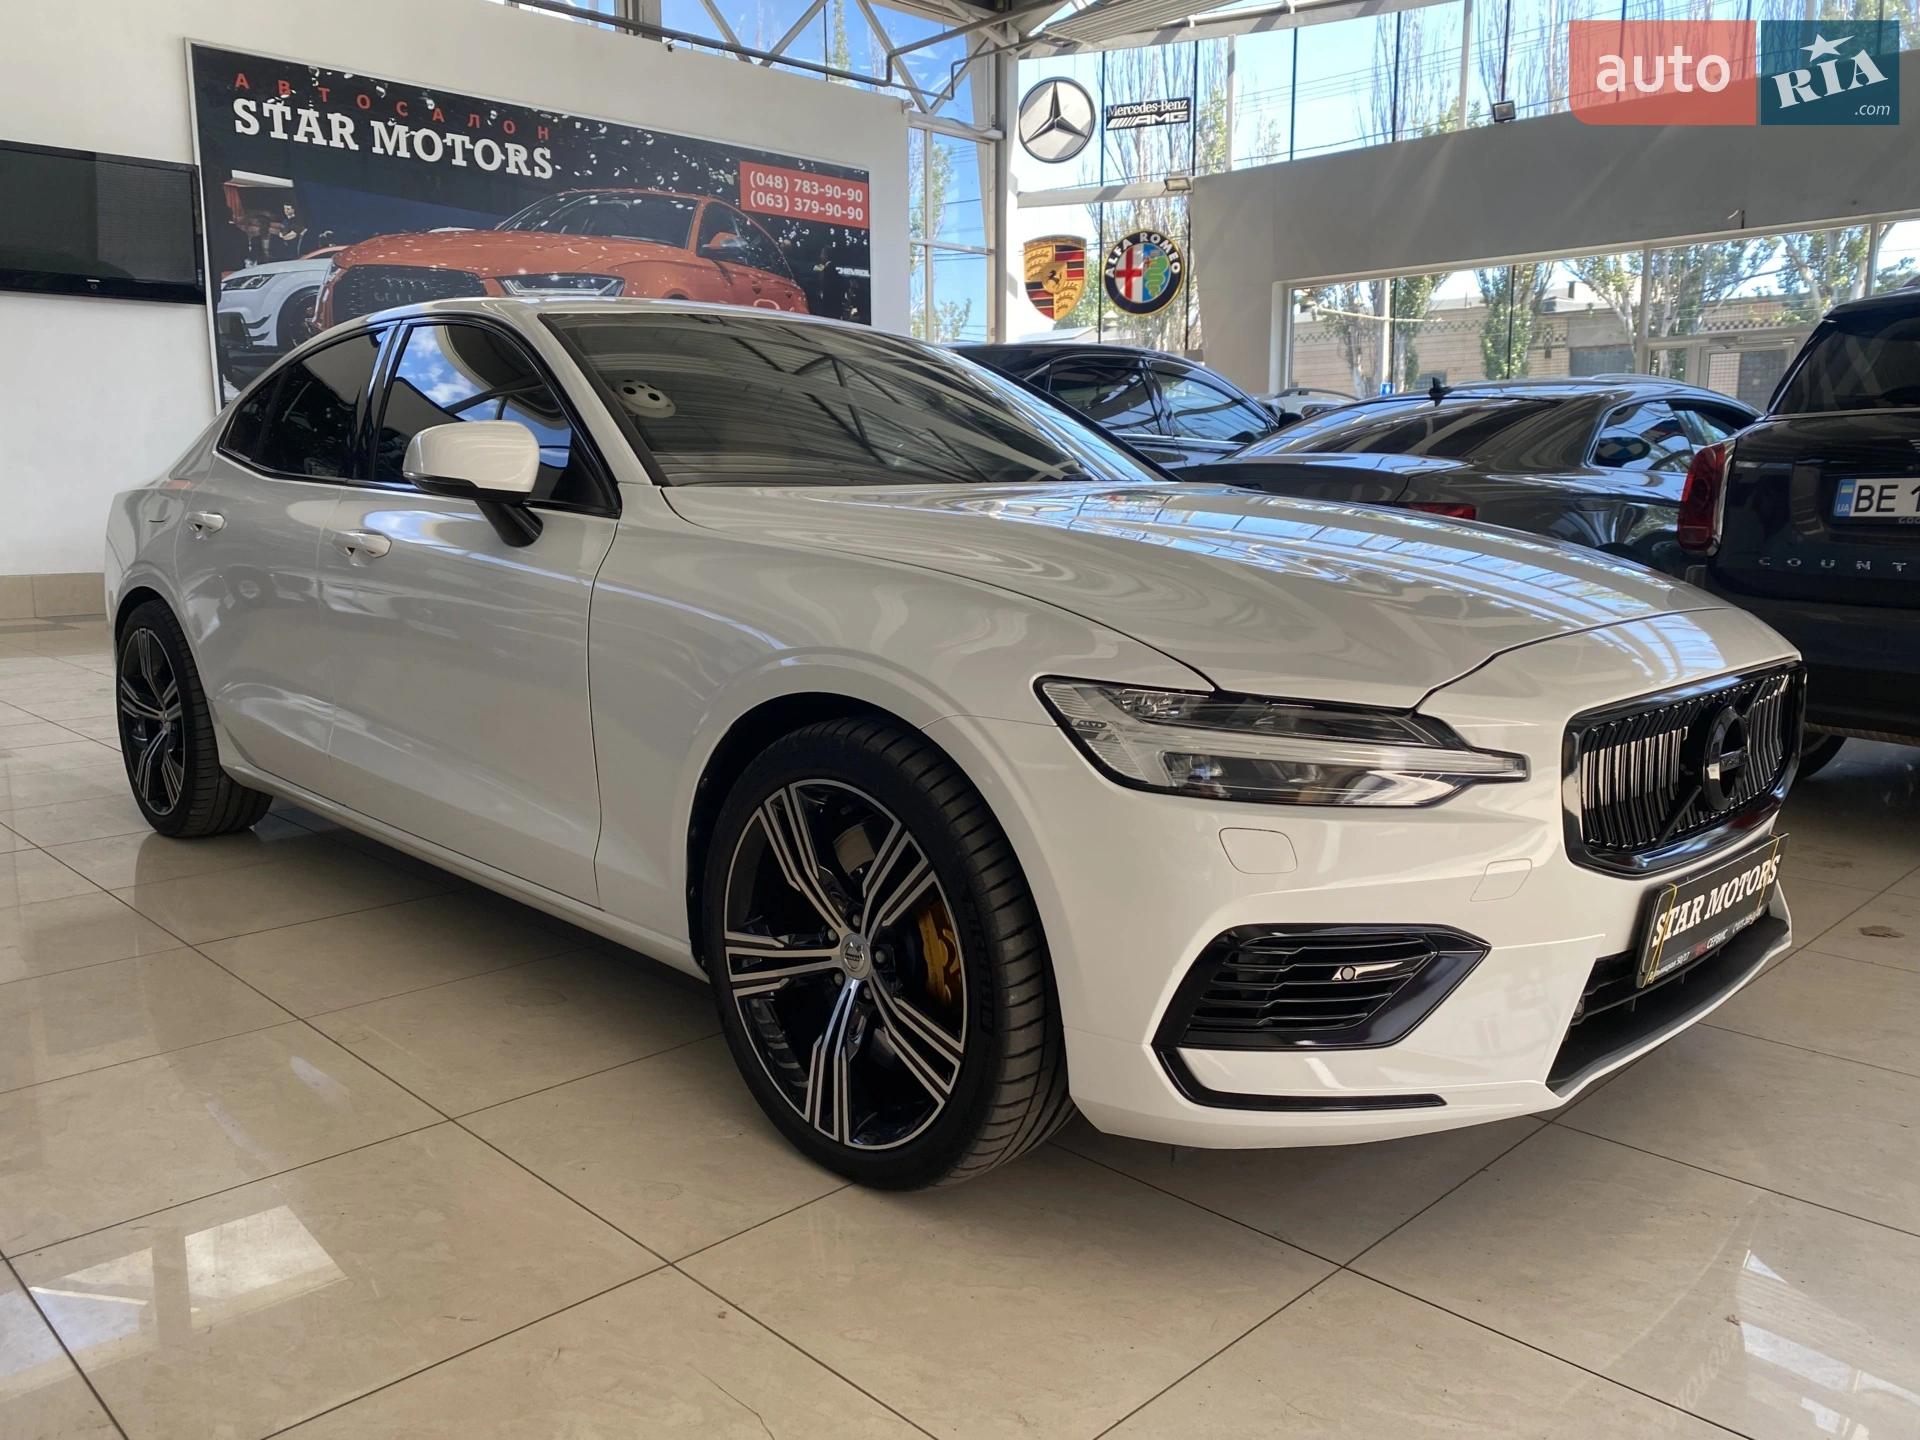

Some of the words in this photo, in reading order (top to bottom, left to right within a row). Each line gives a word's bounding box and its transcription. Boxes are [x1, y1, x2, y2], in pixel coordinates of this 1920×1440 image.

[234, 72, 550, 141] АВТОСАЛОН
[1106, 98, 1188, 117] Mercedes-Benz
[1133, 111, 1189, 126] AMG
[232, 97, 360, 151] STAR
[370, 119, 553, 179] MOTORS
[749, 170, 790, 193] (048)
[793, 178, 863, 203] 783-90-90
[750, 190, 790, 213] (063)
[793, 198, 864, 221] 379-90-90
[1105, 238, 1133, 279] ALFA
[1139, 231, 1180, 275] ROMEO
[1836, 503, 1849, 513] UA
[1853, 484, 1899, 513] BE
[1758, 557, 1908, 572] COUNT
[1651, 894, 1705, 948] STAR
[1704, 853, 1782, 921] MOTORS
